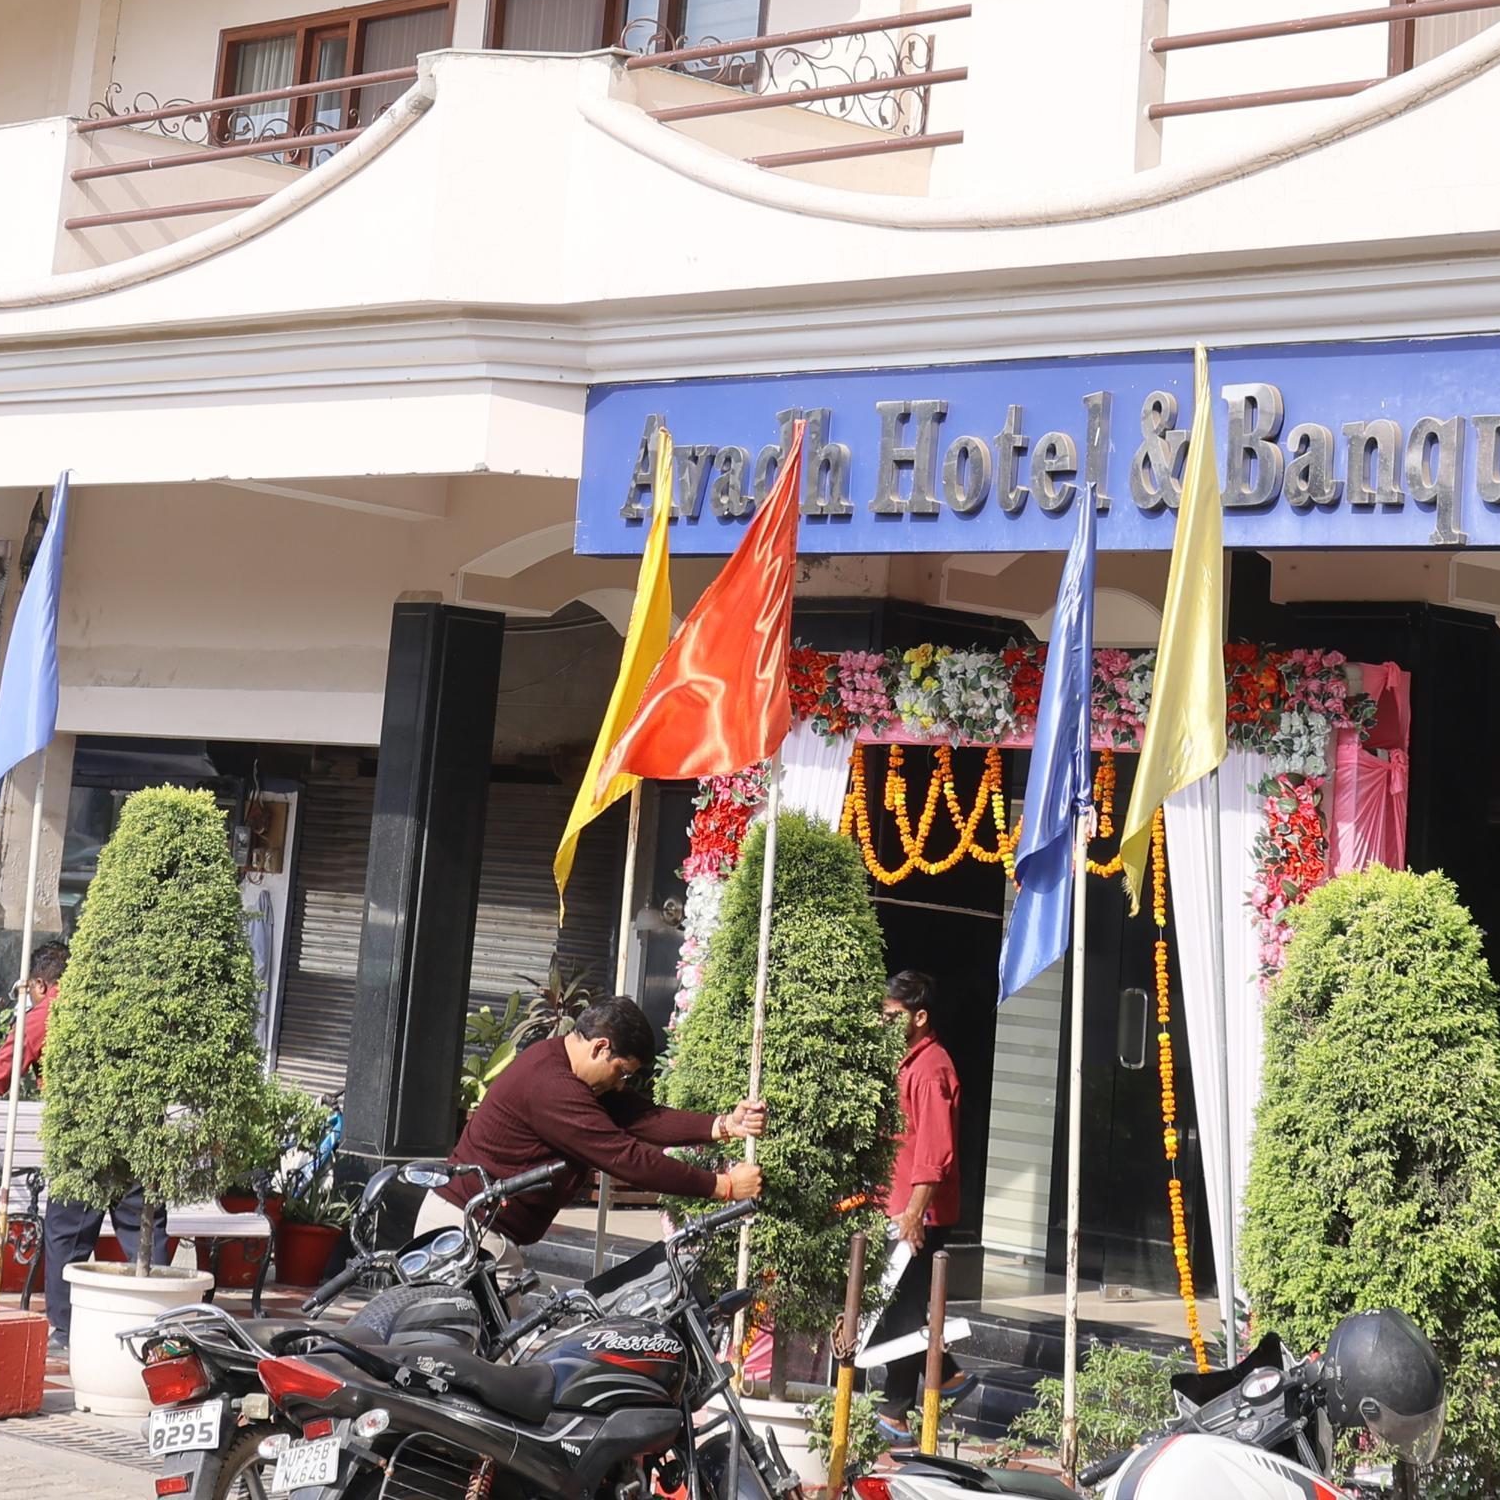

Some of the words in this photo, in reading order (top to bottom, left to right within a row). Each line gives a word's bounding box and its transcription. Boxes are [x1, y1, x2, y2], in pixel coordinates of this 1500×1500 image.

[868, 391, 1112, 515] Hotel
[1129, 390, 1192, 511] &
[455, 1299, 476, 1311] Hero
[582, 1330, 684, 1354] Passion
[152, 1421, 213, 1450] 8295
[560, 1440, 581, 1456] Hero
[287, 1441, 331, 1468] UP25B
[283, 1462, 327, 1489] N4649
